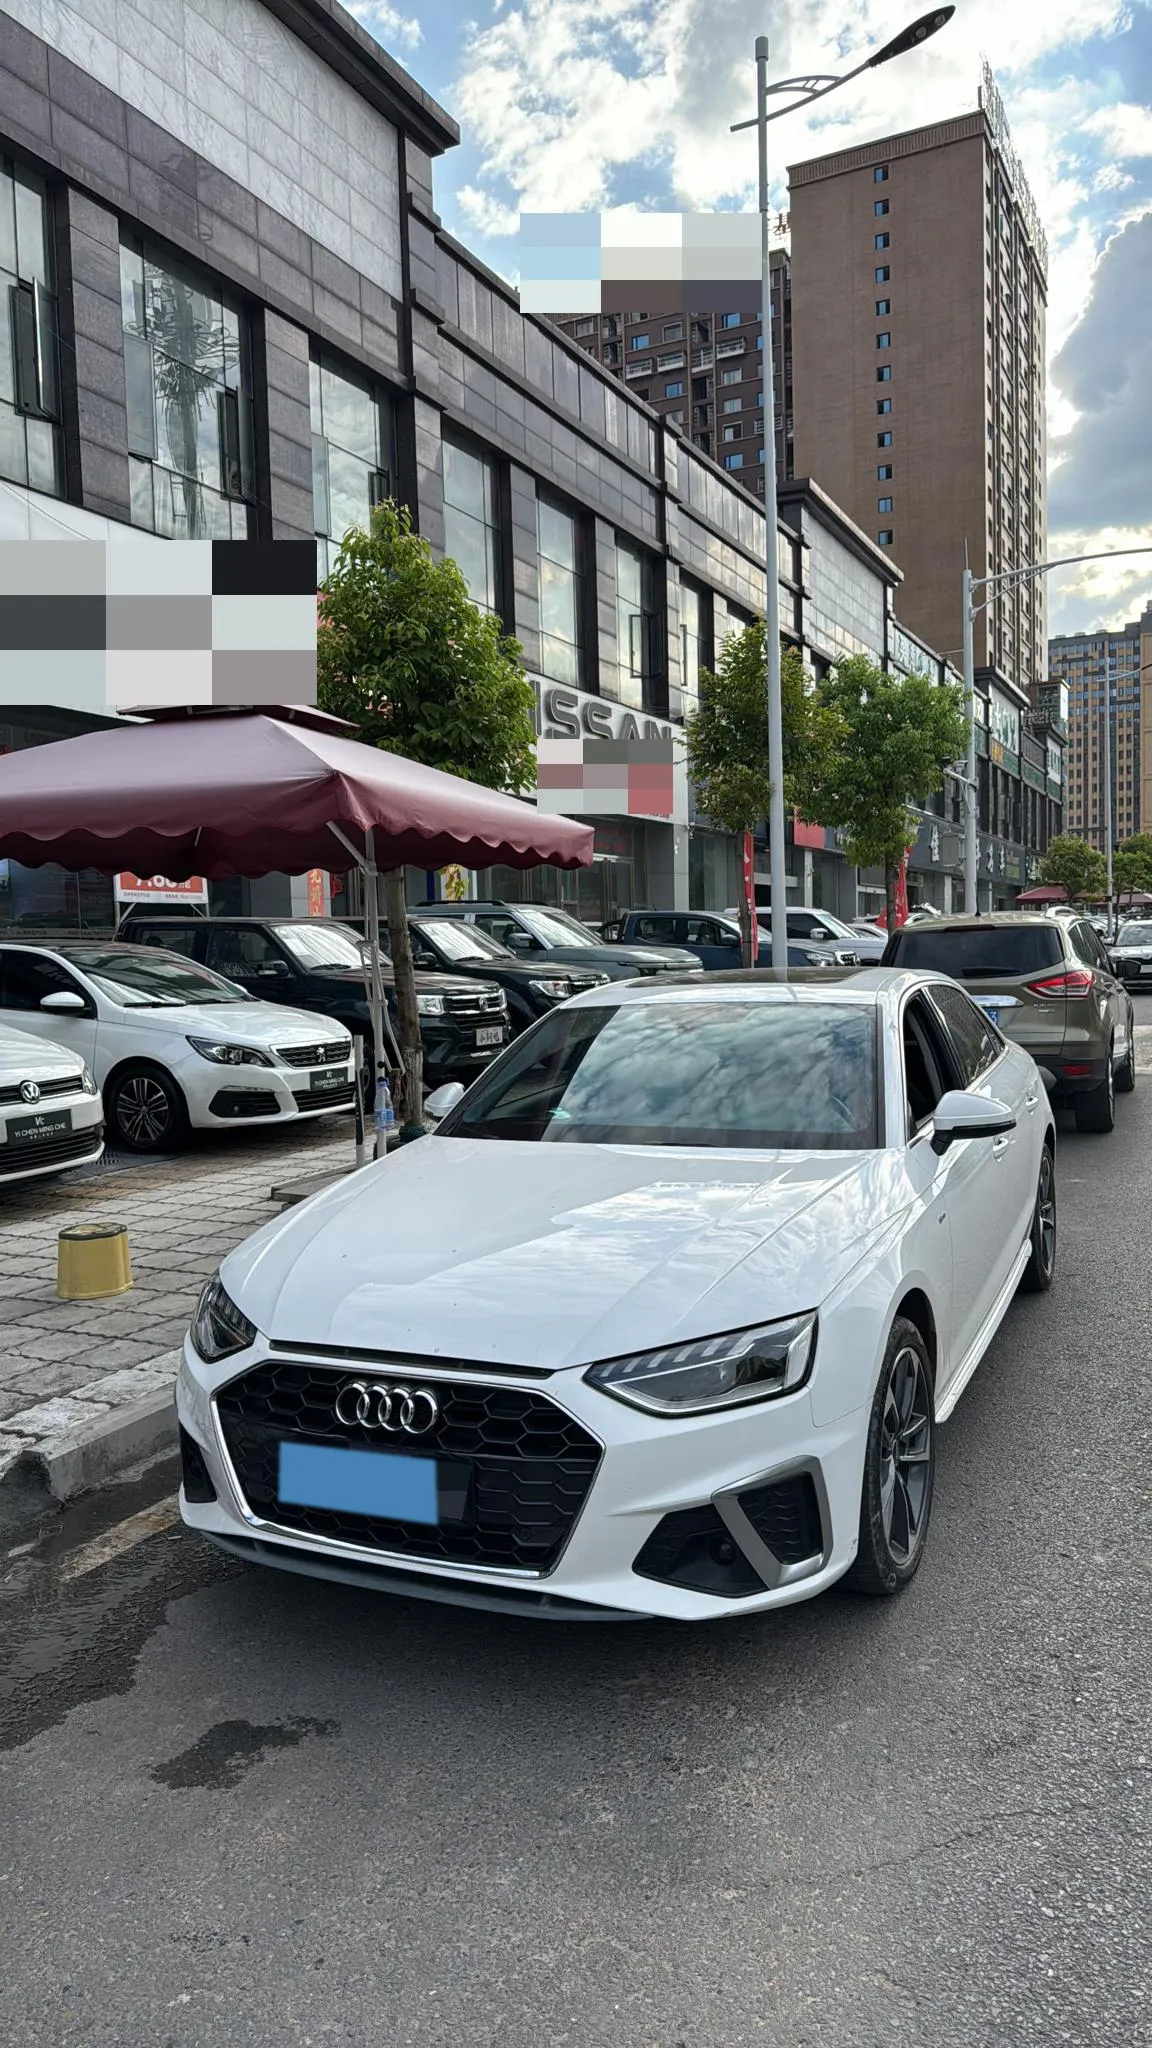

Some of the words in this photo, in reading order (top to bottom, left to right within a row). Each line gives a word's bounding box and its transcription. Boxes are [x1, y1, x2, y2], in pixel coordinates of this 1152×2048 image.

[529, 680, 672, 740] ISSAN
[21, 1127, 38, 1137] CHEN
[39, 1124, 54, 1133] MING
[55, 1122, 67, 1130] CHE
